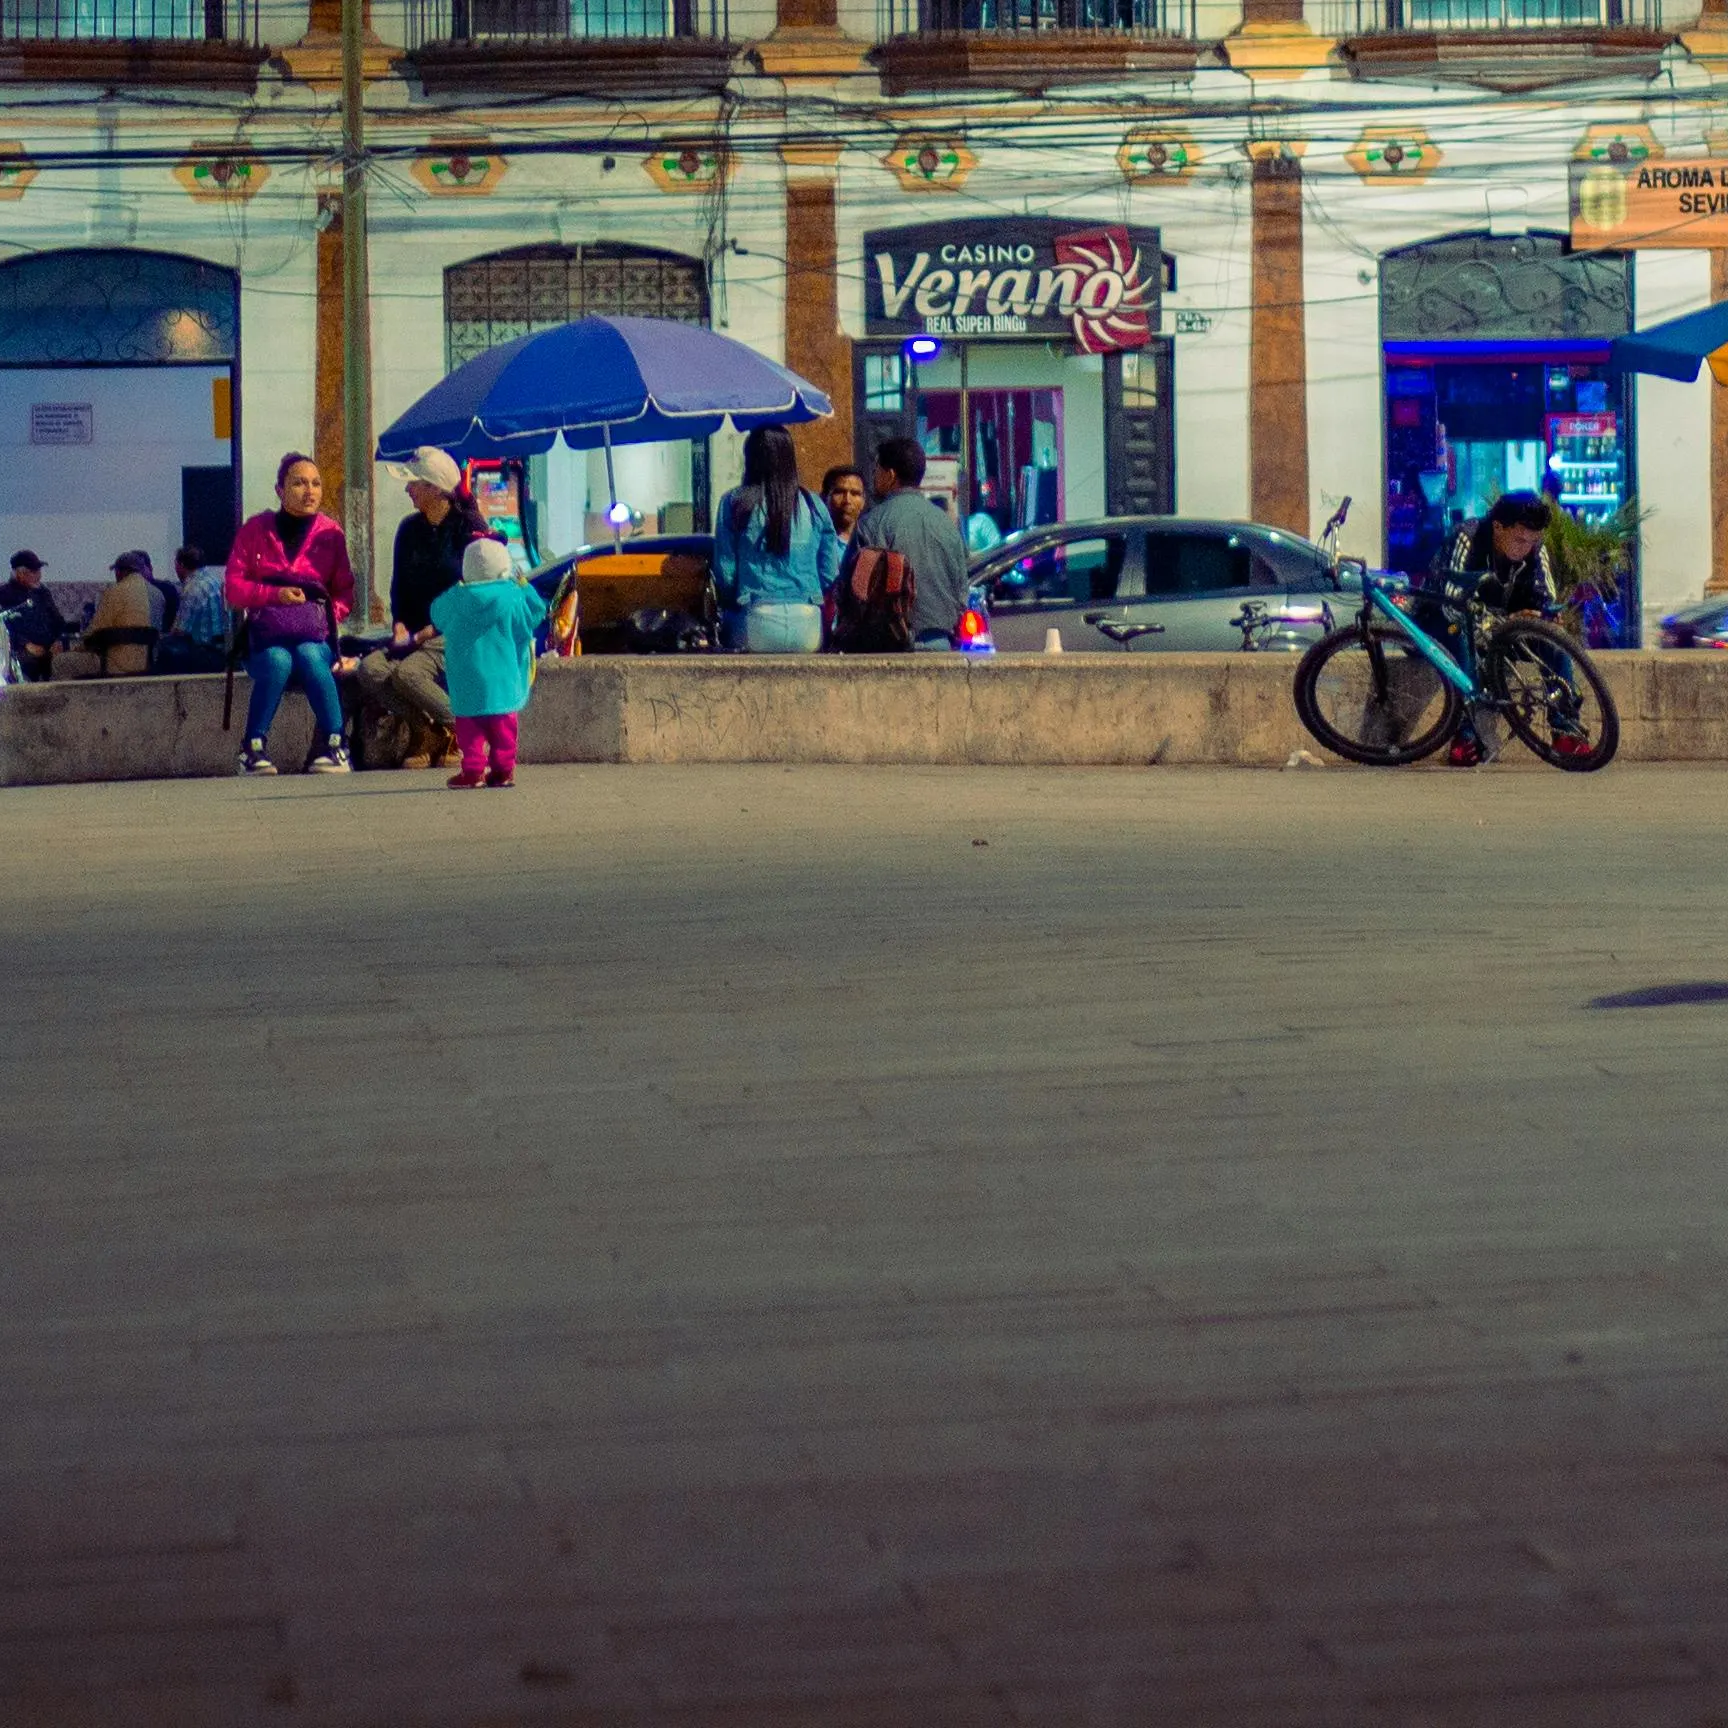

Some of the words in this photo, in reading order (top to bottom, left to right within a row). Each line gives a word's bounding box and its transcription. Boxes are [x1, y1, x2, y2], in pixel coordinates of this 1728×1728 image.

[1637, 167, 1714, 188] AROMA
[941, 243, 1035, 263] CASINO
[875, 251, 1125, 319] Verano
[926, 315, 953, 333] REAL
[956, 315, 991, 333] SUPER
